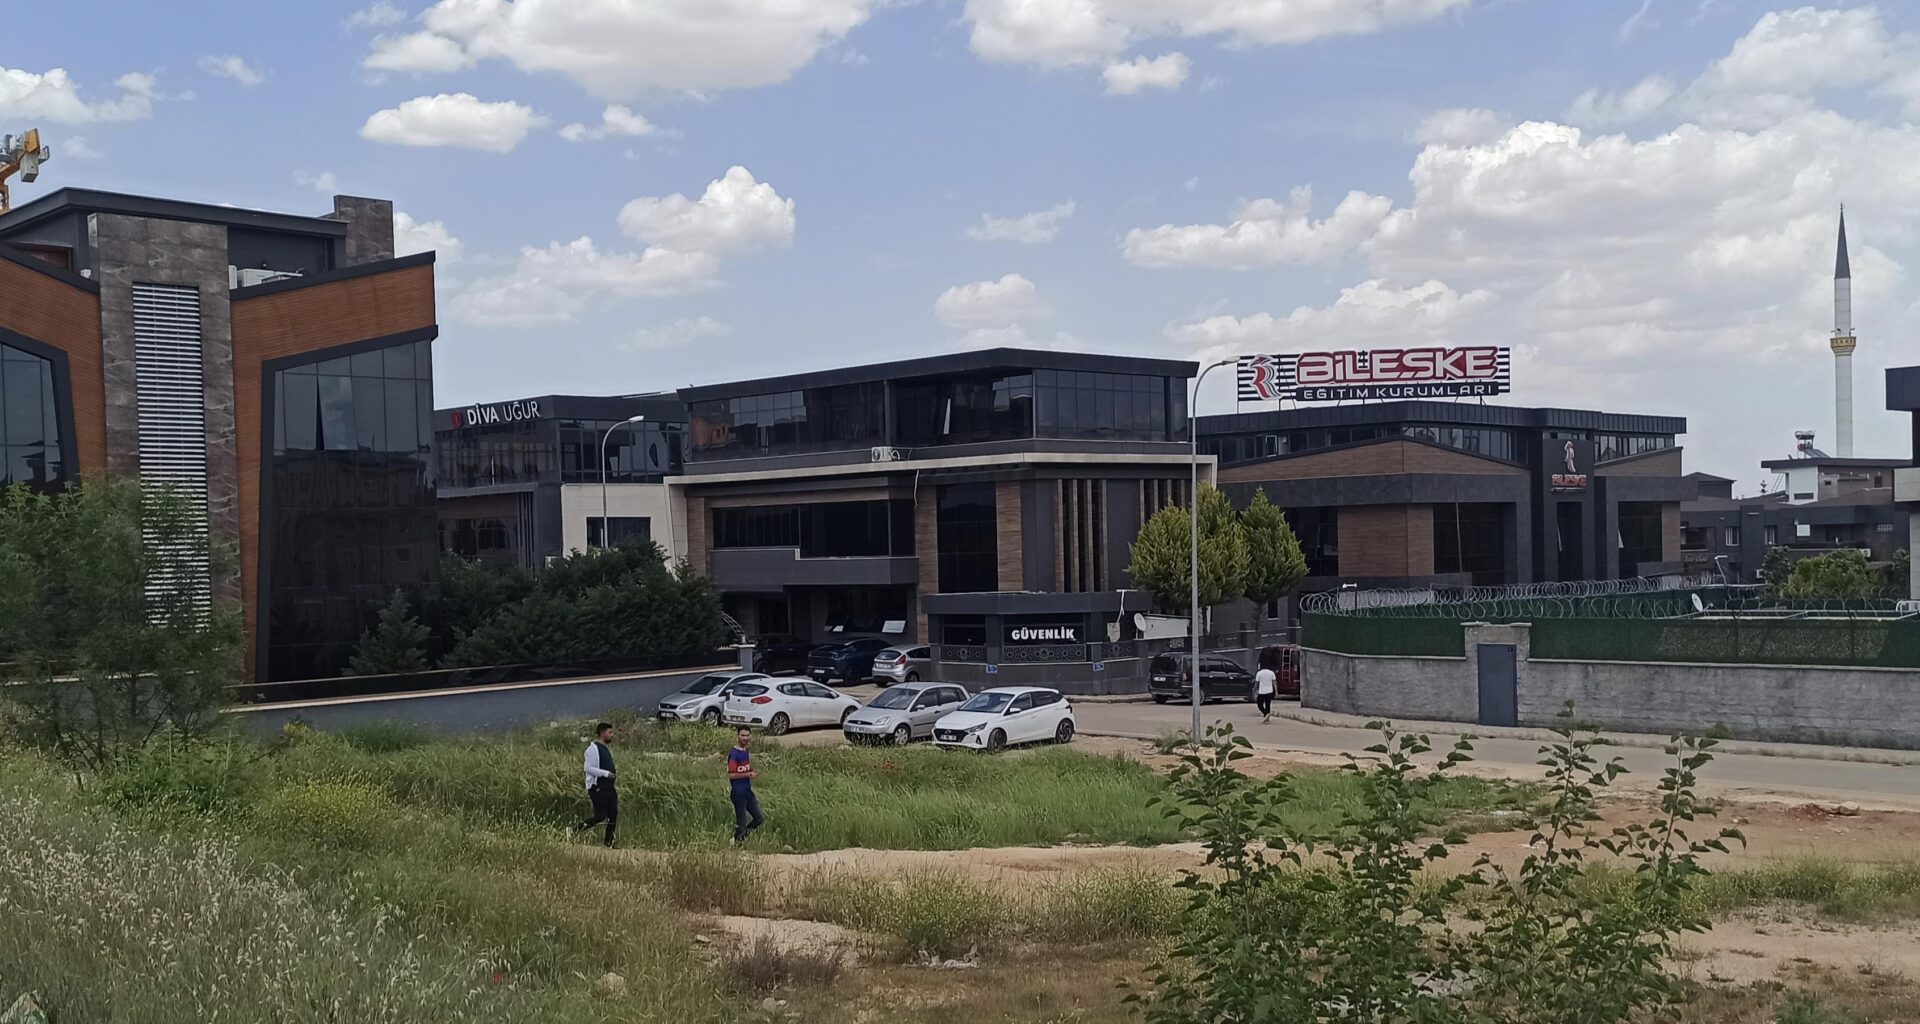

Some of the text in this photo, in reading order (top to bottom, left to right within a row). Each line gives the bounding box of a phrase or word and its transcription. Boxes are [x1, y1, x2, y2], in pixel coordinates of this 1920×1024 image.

[1376, 384, 1492, 398] KURUMLARI
[466, 401, 540, 425] DİVA UĞUR
[1011, 626, 1075, 641] GÜVENLİK
